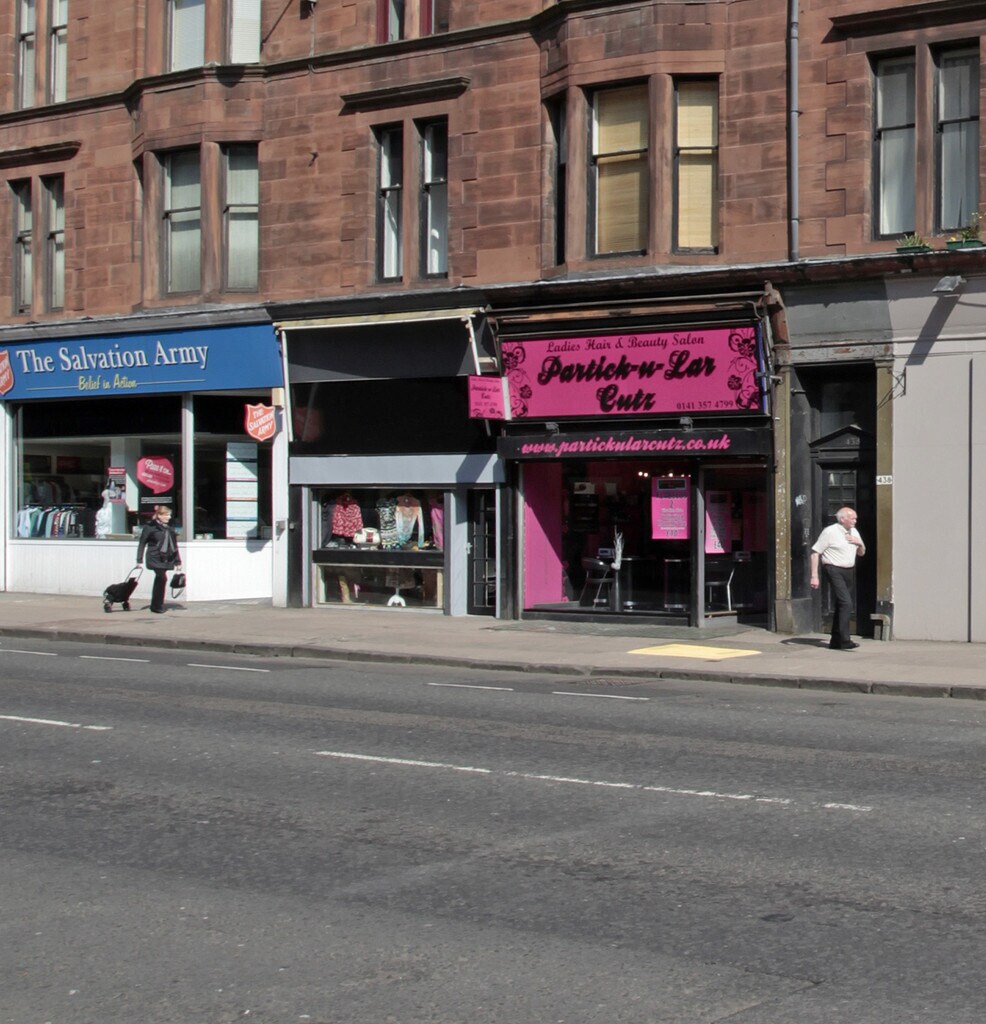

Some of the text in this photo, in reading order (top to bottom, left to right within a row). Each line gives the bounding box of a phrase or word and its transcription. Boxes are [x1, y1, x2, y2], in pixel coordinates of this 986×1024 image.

[546, 333, 705, 353] Ladies Hair & Beauty Salon
[16, 348, 55, 374] The
[59, 344, 148, 371] Salvation
[154, 340, 209, 369] Army
[78, 374, 138, 391] Belief in Action
[596, 384, 657, 413] Cutz
[676, 400, 734, 410] 0141 357 4799
